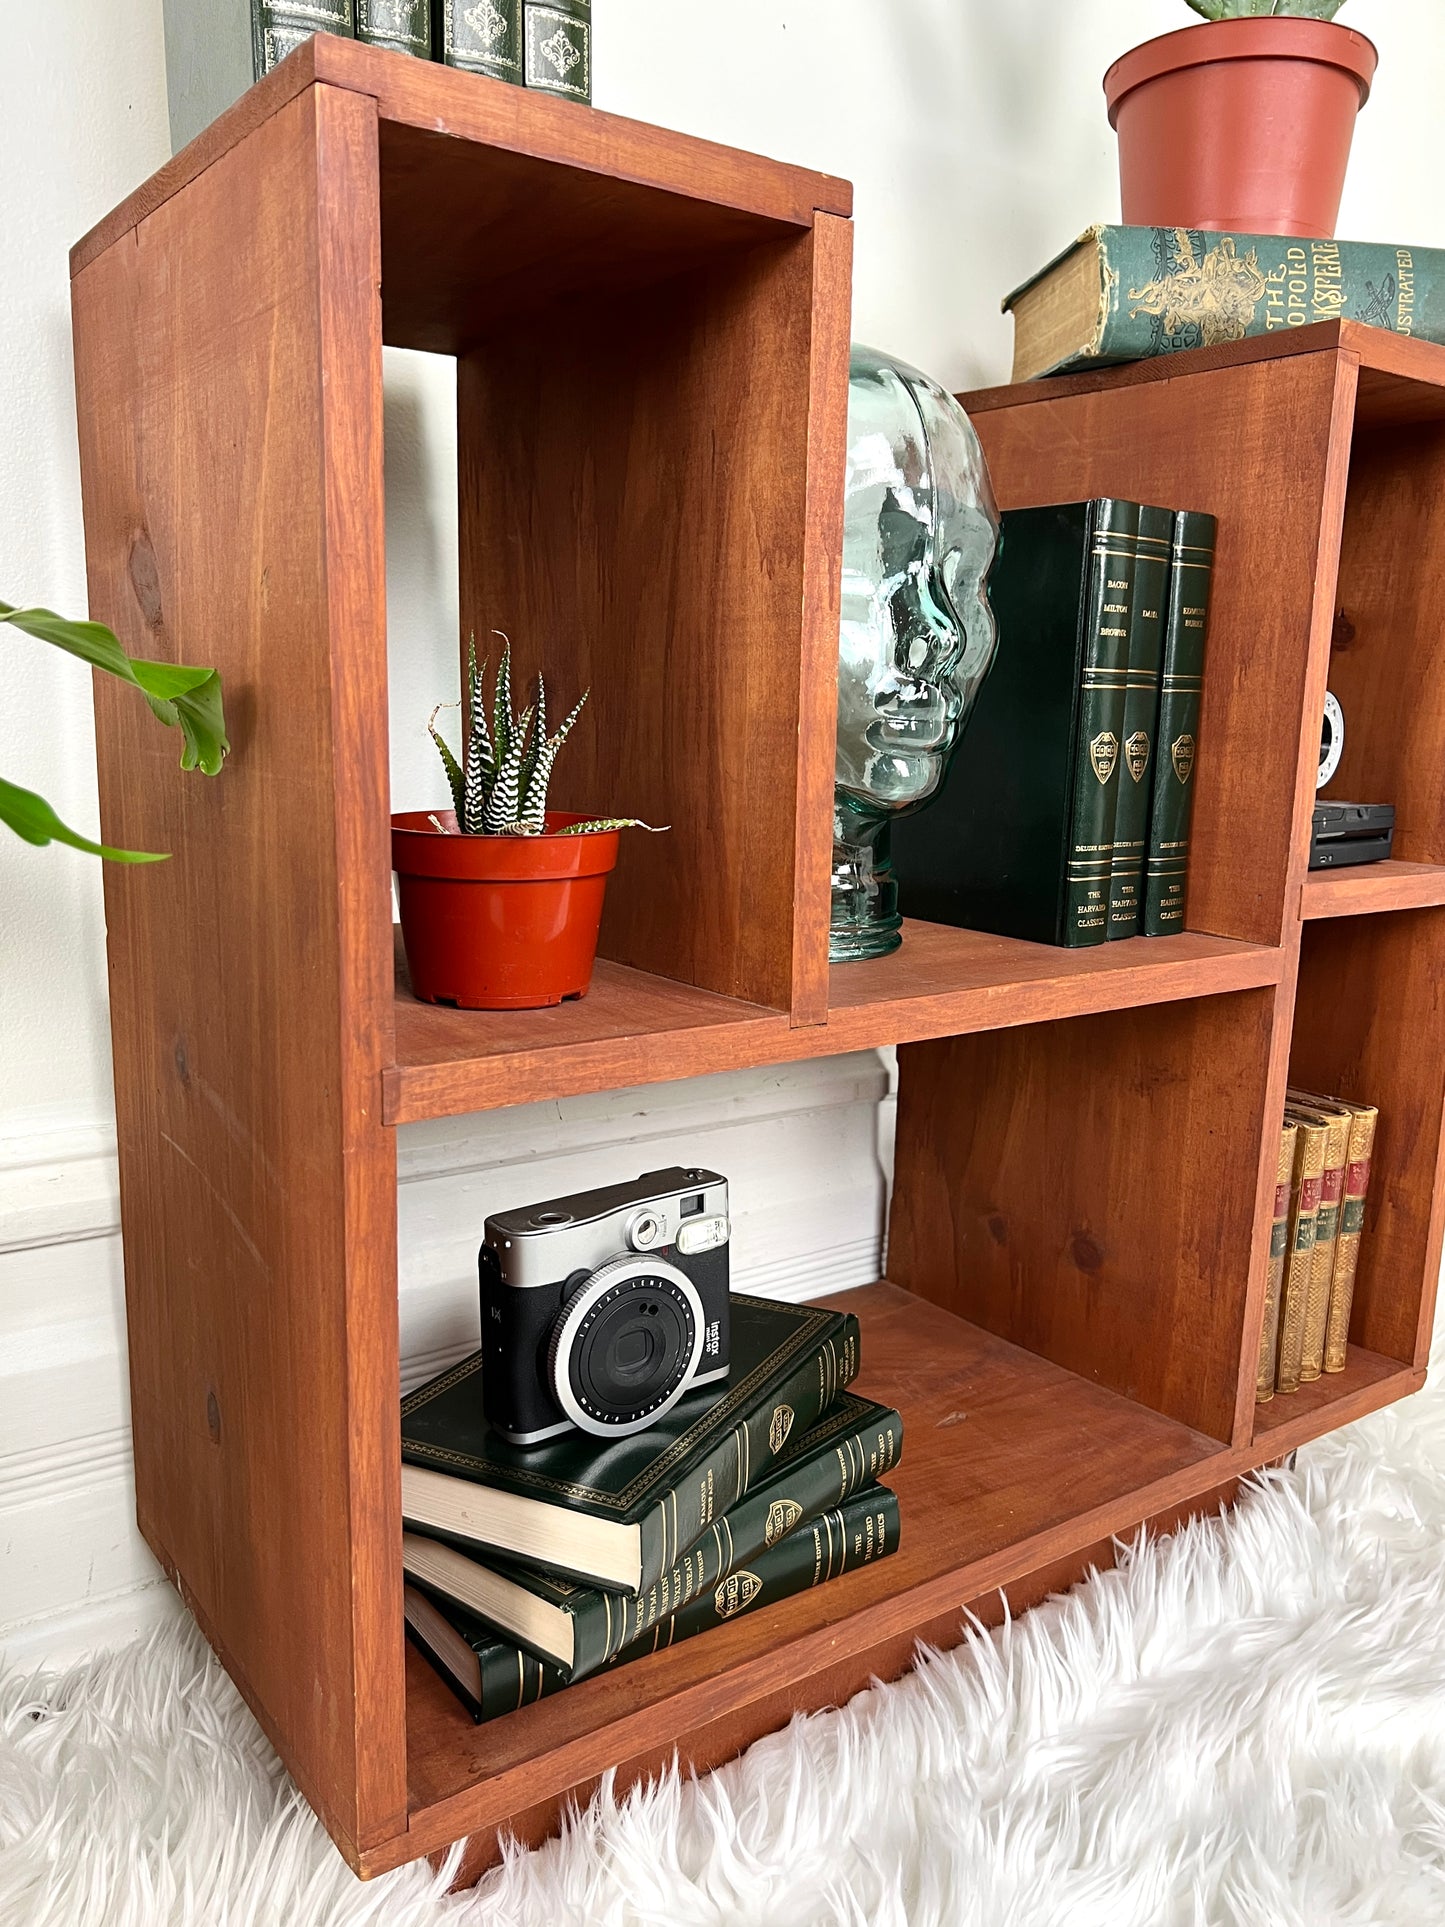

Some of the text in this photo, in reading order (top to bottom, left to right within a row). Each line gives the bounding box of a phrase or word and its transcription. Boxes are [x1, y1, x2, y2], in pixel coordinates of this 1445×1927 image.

[1266, 264, 1287, 329] THE
[1287, 247, 1308, 326] OPOLD
[1311, 242, 1347, 323] KSPERE
[1396, 249, 1414, 336] USTRATED
[1107, 580, 1128, 590] BACON
[1103, 604, 1128, 614] MILTON
[1077, 904, 1106, 914] HARVARD
[1088, 891, 1101, 899] THE
[1121, 885, 1135, 894] THE
[1169, 885, 1180, 893] THE
[1077, 917, 1105, 928] CLASSICS
[579, 1289, 620, 1338] INSTAX
[632, 1280, 663, 1288] LENS
[705, 1343, 711, 1353] 90
[710, 1320, 721, 1356] instax
[836, 1447, 847, 1480] EDITION
[814, 1528, 822, 1560] EDITION
[865, 1516, 874, 1561] HARVARD
[877, 1513, 886, 1555] CLASSICS
[659, 1576, 669, 1617] RUSKIN
[671, 1568, 681, 1610] HUXLEY
[682, 1556, 693, 1605] THOREAU
[632, 1597, 644, 1642] THACKE
[647, 1585, 657, 1627] NEWMA
